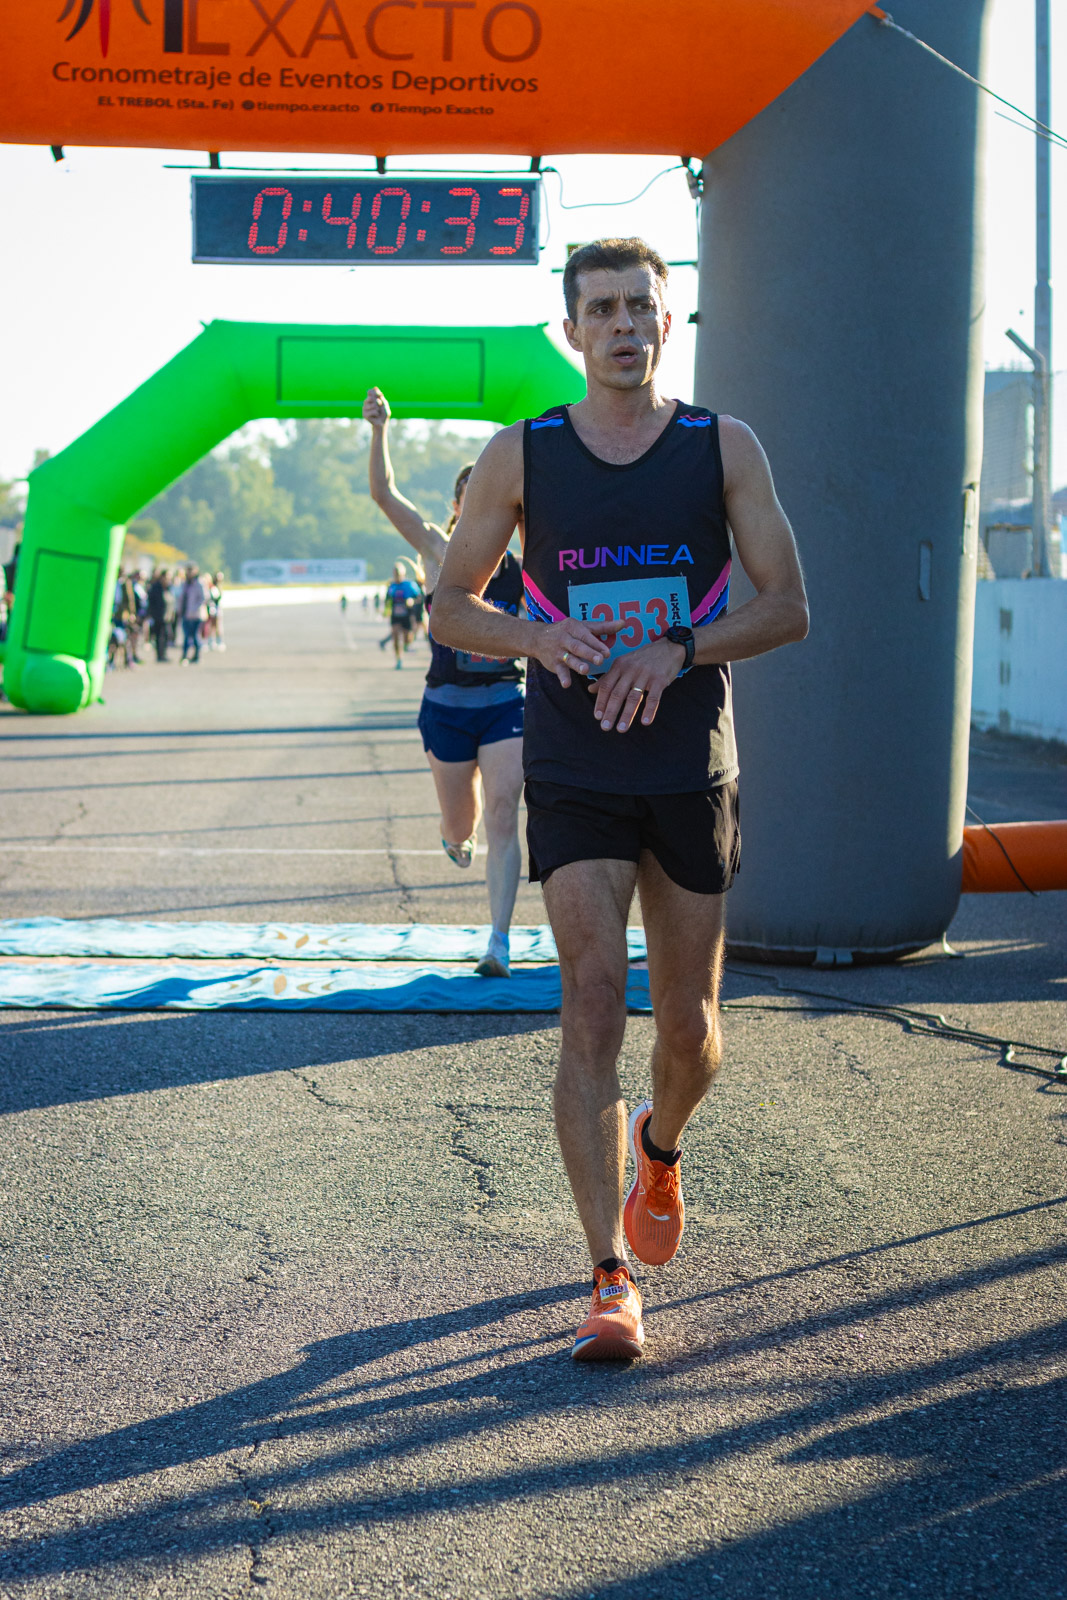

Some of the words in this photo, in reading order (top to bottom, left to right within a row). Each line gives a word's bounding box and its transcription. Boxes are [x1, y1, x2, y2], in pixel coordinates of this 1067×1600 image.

[52, 61, 232, 90] Cronometraje
[238, 66, 272, 87] de
[279, 68, 384, 90] Eventos
[391, 70, 539, 95] Deportivos
[97, 96, 114, 106] EL
[176, 98, 210, 110] (Sta.
[212, 99, 235, 111] Fe)
[257, 101, 360, 114] tiempo.exacto
[387, 103, 443, 116] Tiempo
[445, 104, 495, 116] Exacto
[247, 187, 530, 254] 0:40:33
[558, 544, 695, 572] RUNNEA
[591, 598, 670, 650] 353
